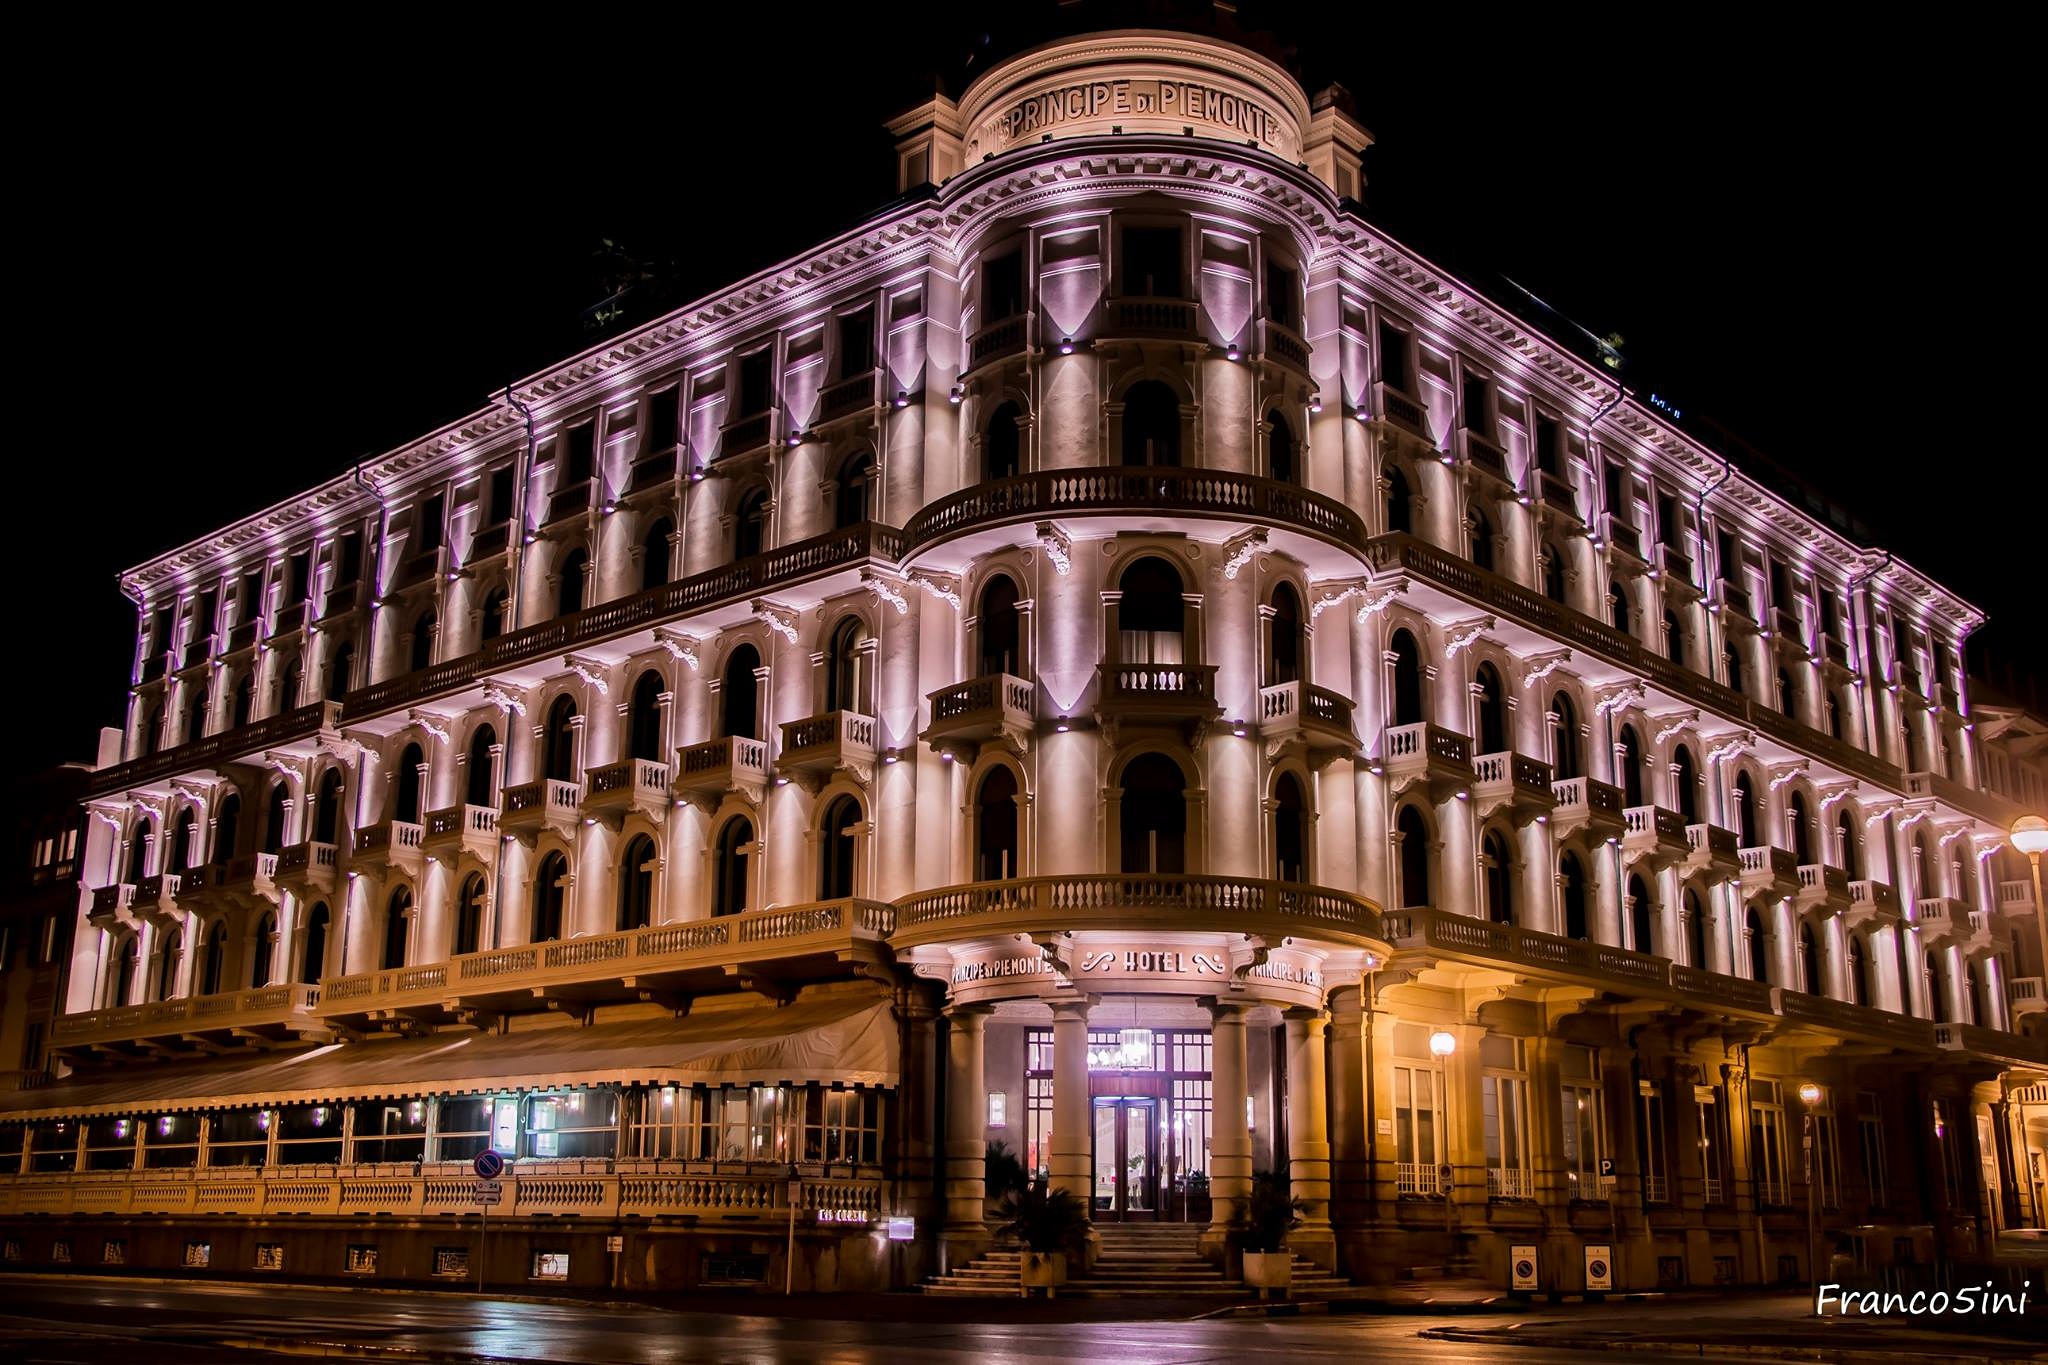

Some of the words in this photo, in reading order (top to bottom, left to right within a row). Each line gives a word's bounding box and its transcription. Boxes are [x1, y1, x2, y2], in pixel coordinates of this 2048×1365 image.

[1008, 81, 1130, 138] PRINCIPE
[1160, 81, 1274, 146] PIEMONTE
[952, 962, 985, 984] PRINCIPE
[994, 956, 1053, 977] PIEMONTE
[1123, 951, 1188, 972] HOTEL
[1250, 961, 1294, 982] RINCIPE
[1602, 1161, 1611, 1174] P
